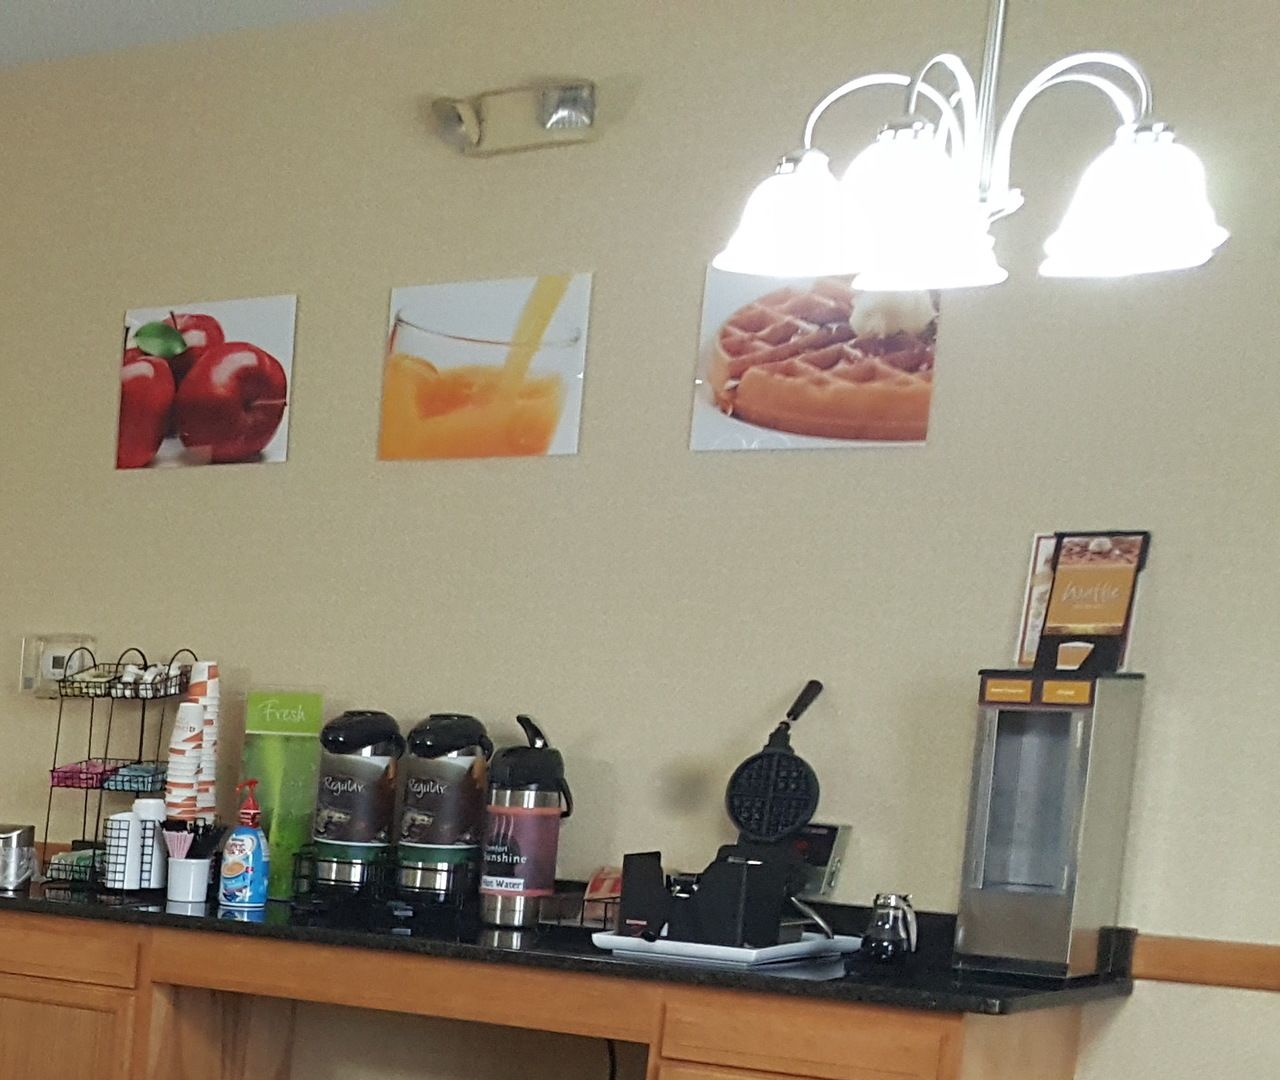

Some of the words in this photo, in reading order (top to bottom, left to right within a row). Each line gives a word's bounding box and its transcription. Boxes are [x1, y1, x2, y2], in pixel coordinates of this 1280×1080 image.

[256, 699, 306, 722] Fresh
[324, 776, 364, 796] Regular
[408, 778, 448, 798] Regular
[496, 879, 522, 889] Water
